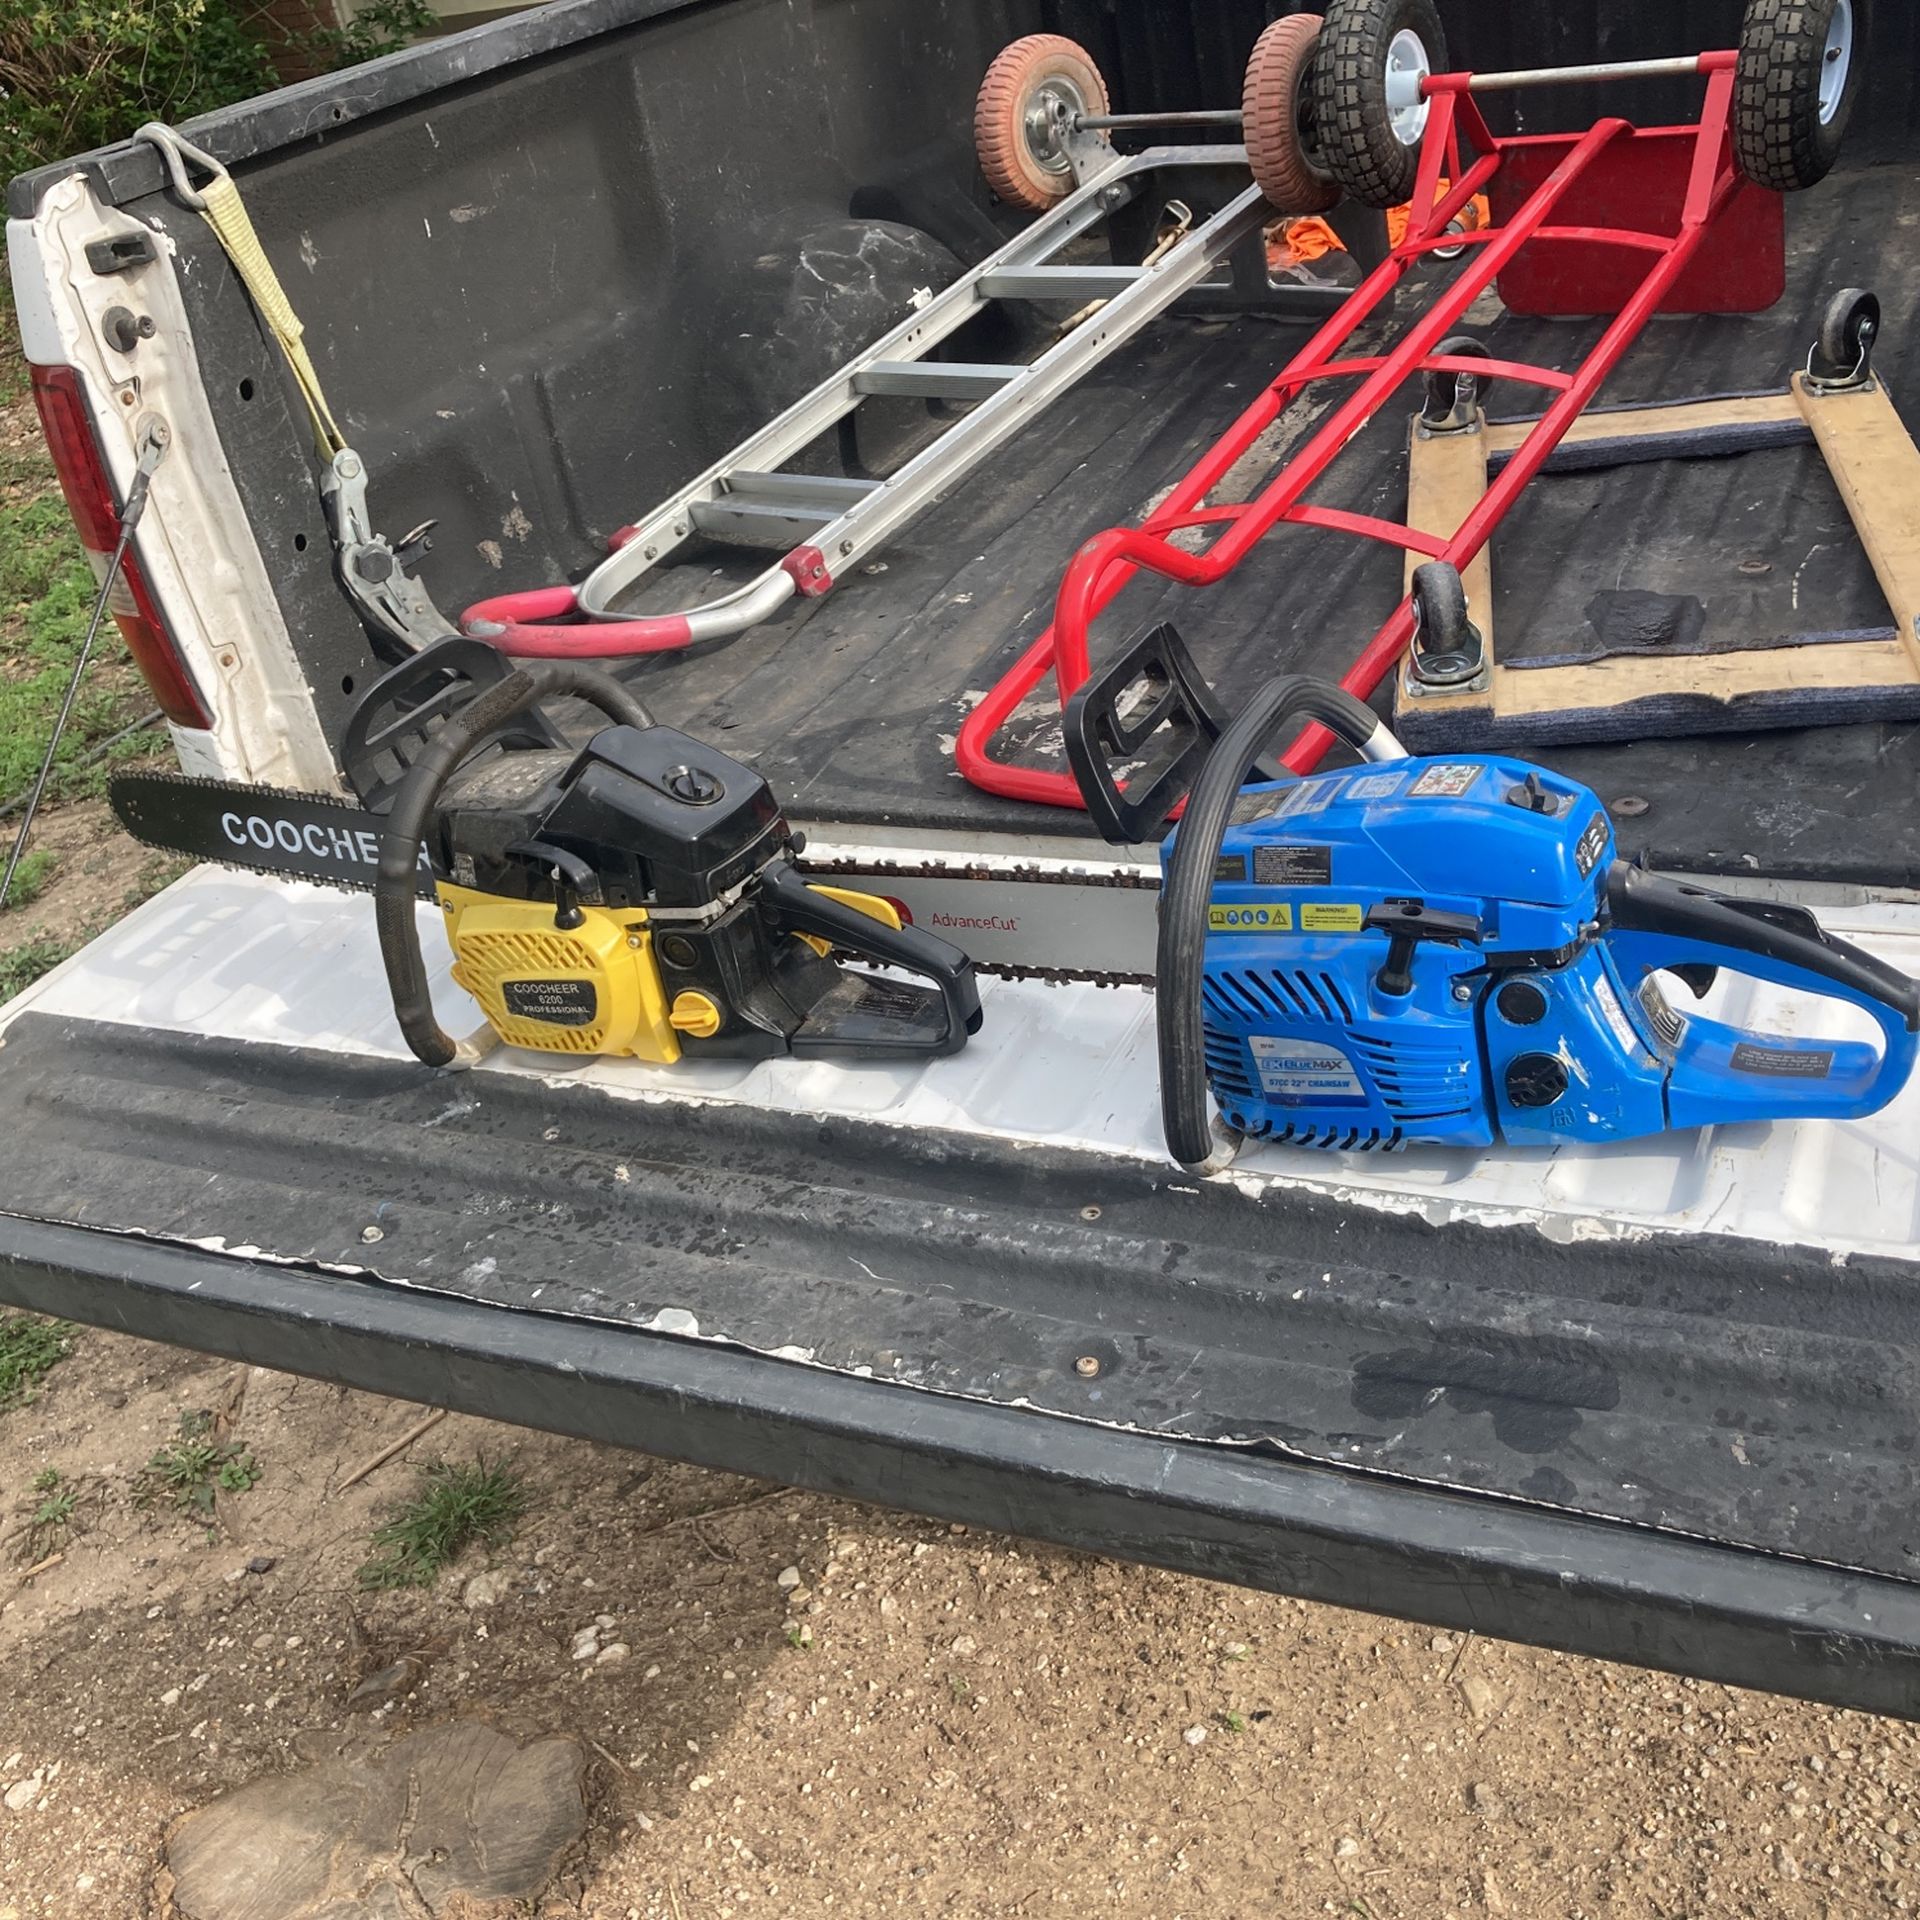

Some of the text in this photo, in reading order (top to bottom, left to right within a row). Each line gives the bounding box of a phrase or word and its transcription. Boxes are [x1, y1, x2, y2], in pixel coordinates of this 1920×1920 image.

[221, 812, 432, 871] COOCHER
[513, 983, 580, 994] COOCHEER
[538, 995, 564, 1005] 6200
[523, 1005, 591, 1014] PROFESSIONAL
[1308, 1080, 1352, 1089] CHAINSAW
